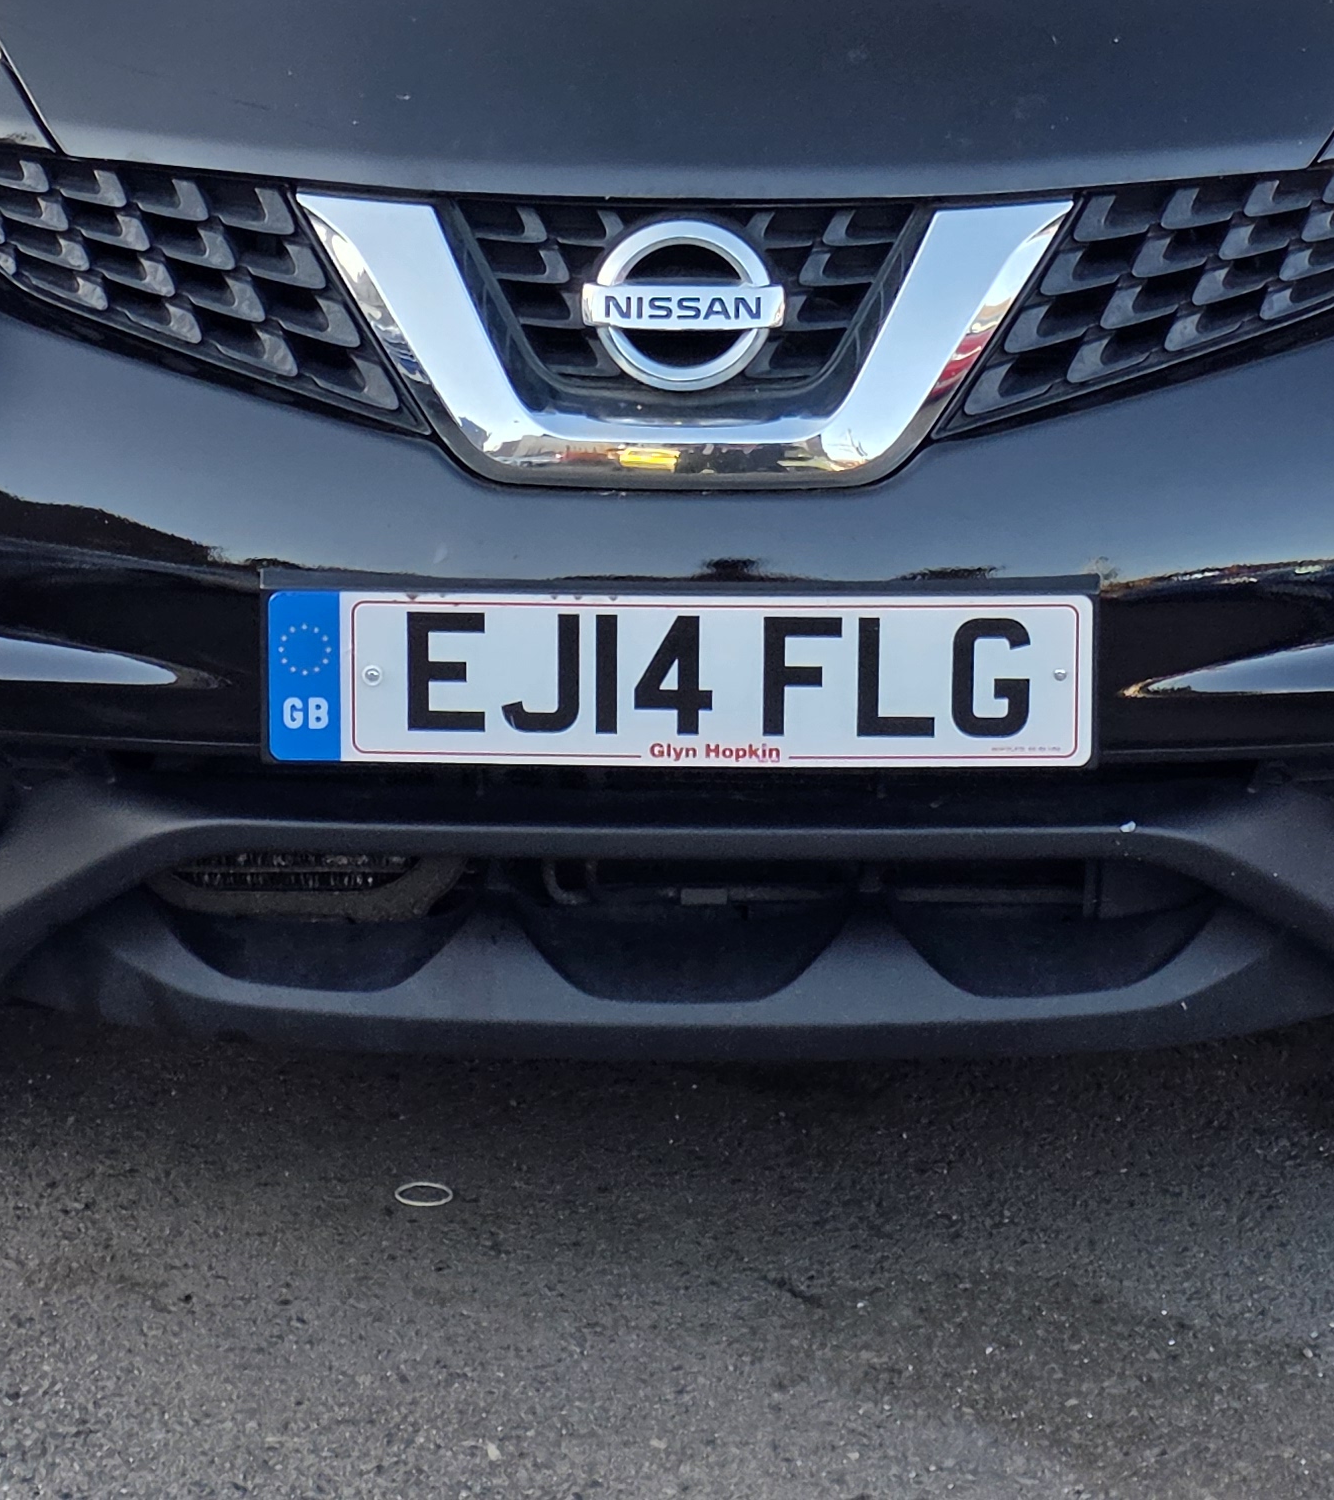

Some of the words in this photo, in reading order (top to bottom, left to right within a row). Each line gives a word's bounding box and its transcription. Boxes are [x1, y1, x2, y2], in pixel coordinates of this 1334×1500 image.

[604, 295, 762, 320] NISSAN
[406, 610, 713, 735] EJ14
[762, 615, 1032, 739] FLG
[282, 696, 330, 730] GB
[649, 743, 697, 762] Glyn
[704, 743, 781, 763] Hopkin
